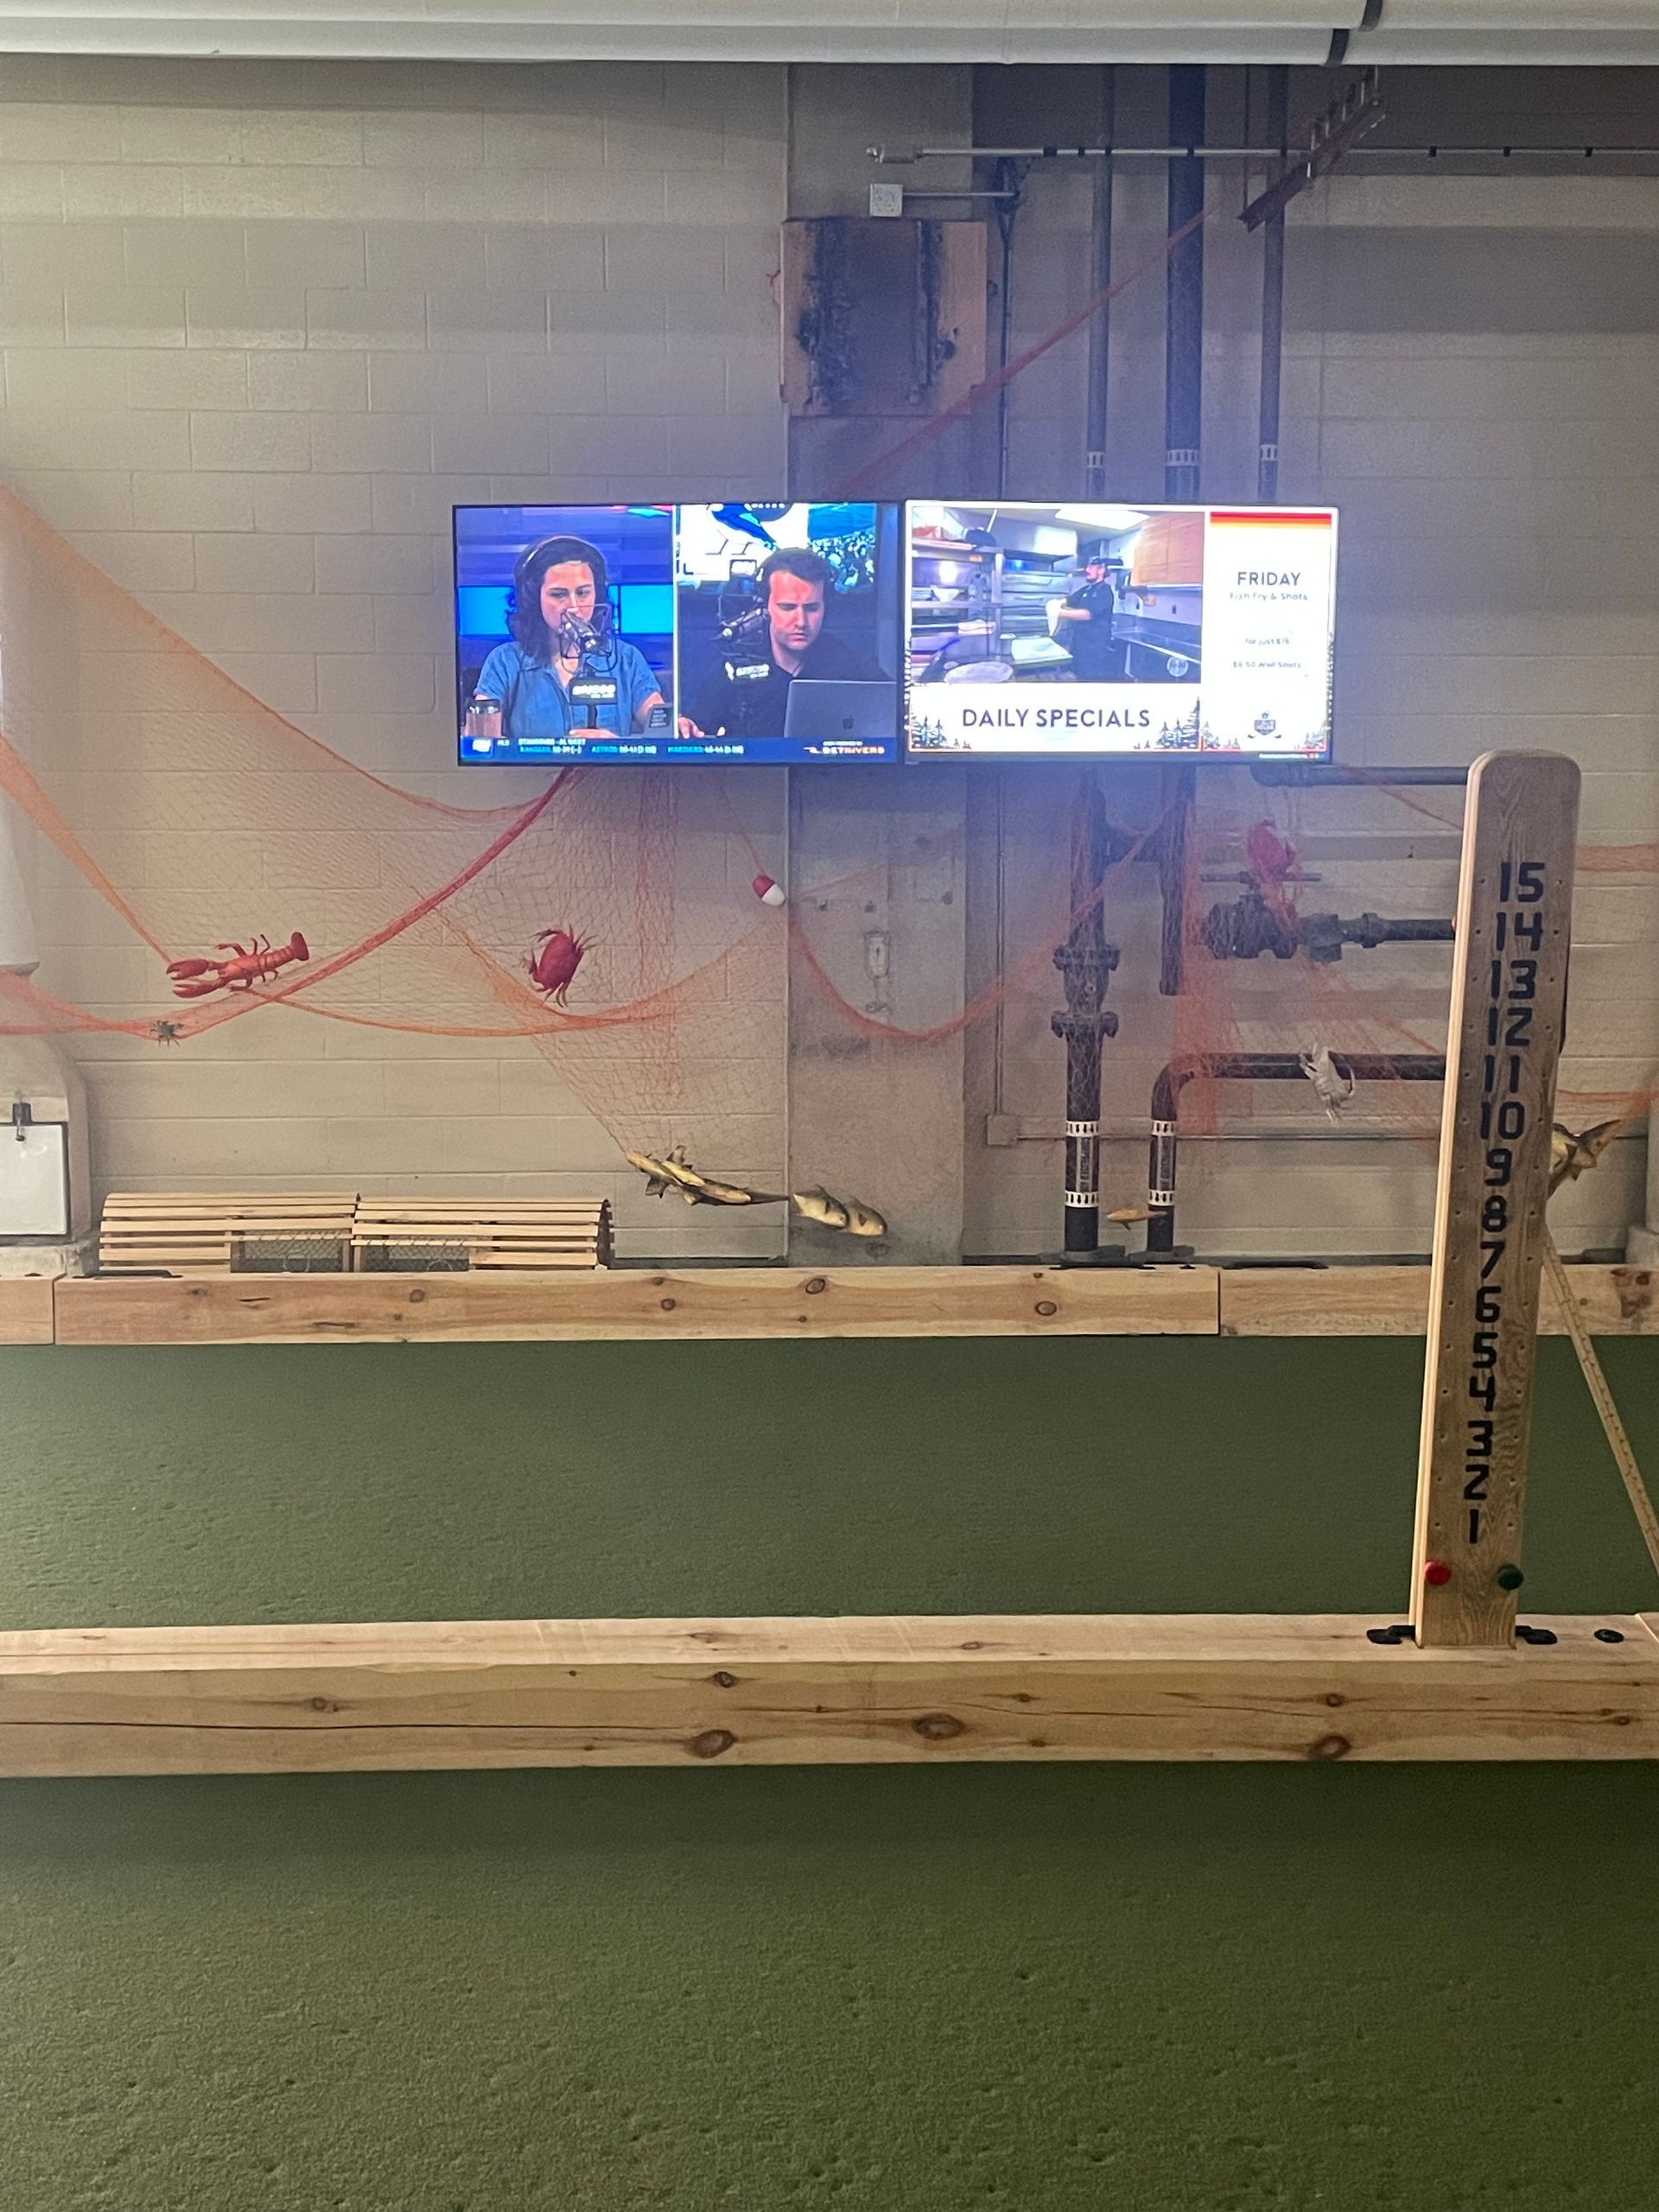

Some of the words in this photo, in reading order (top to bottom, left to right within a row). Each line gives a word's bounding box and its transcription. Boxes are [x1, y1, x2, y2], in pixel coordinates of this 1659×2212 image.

[1237, 571, 1300, 586] FRIDAY
[963, 709, 1029, 728] DAILY
[1036, 709, 1150, 728] SPECIALS
[1499, 861, 1545, 903] 15
[1496, 912, 1543, 951] 14
[1491, 959, 1537, 1000] 13
[1488, 1007, 1533, 1046] 12
[1484, 1054, 1521, 1093] 11
[1480, 1101, 1525, 1140] 10
[1484, 1148, 1512, 1186] 9
[1481, 1194, 1508, 1233] 8
[1480, 1241, 1506, 1279] 7
[1475, 1286, 1502, 1323] 6
[1472, 1332, 1498, 1369] 5
[1469, 1376, 1496, 1412] 4
[1466, 1421, 1493, 1457] 3
[1463, 1465, 1490, 1501] 2
[1469, 1509, 1479, 1544] 1
